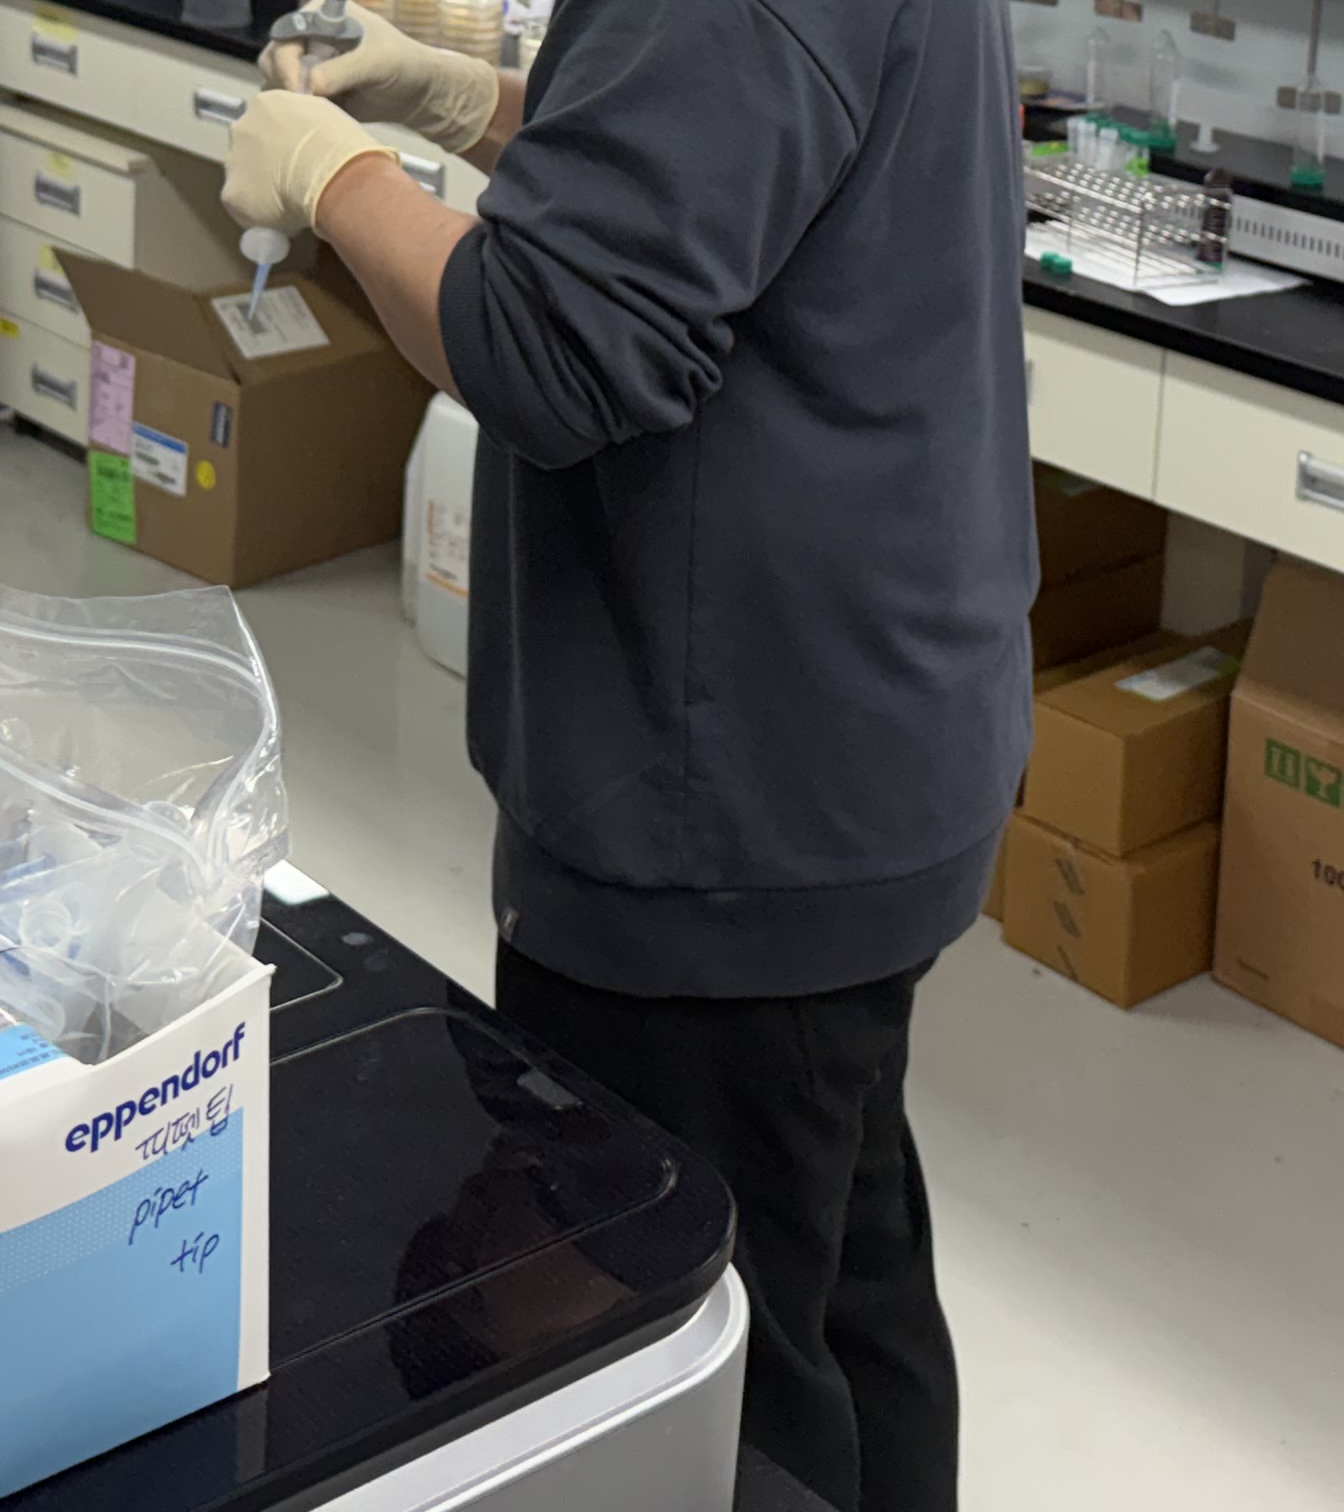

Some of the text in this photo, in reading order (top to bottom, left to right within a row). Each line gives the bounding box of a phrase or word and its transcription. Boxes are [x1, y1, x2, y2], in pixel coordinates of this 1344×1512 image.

[65, 1021, 246, 1153] eppendorf
[128, 1169, 209, 1245] pipet
[170, 1231, 220, 1274] tip
